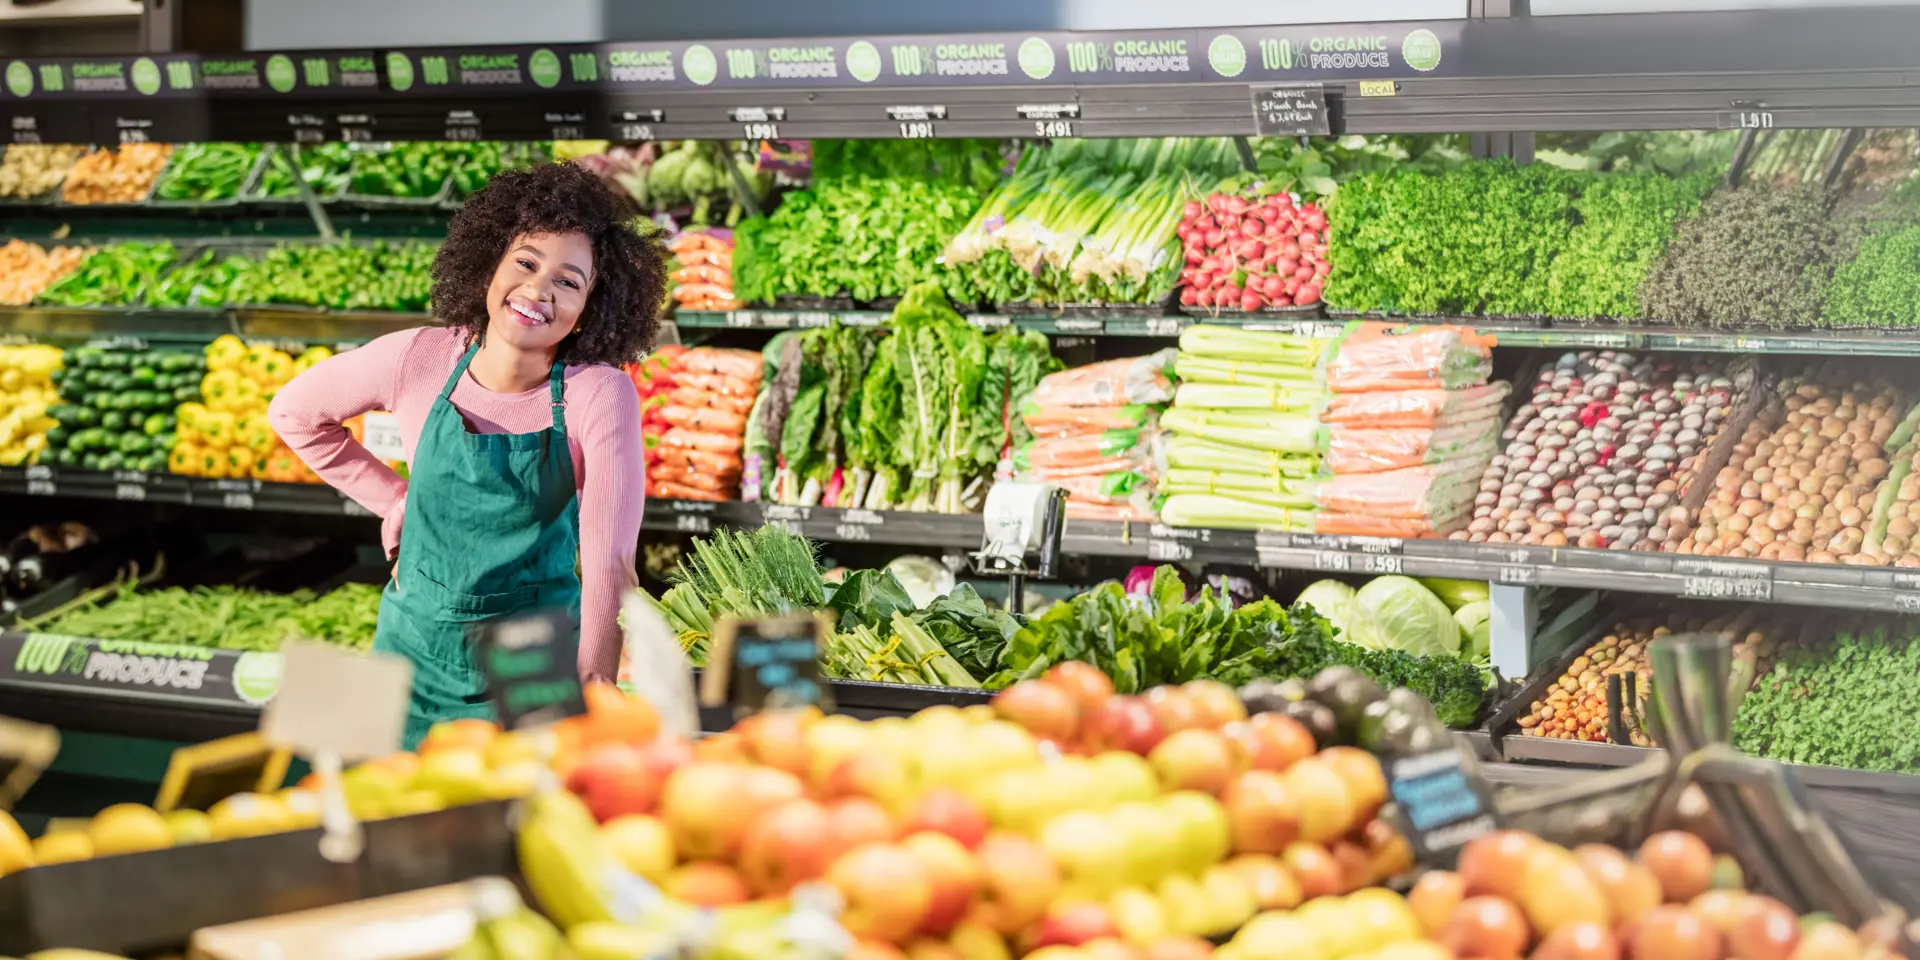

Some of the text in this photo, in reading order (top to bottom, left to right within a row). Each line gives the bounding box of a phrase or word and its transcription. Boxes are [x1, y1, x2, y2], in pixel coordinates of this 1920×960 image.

[769, 47, 835, 62] ORGANIC
[891, 44, 1006, 75] 100% ORGANIC
[1066, 42, 1112, 73] 100%
[1114, 40, 1187, 56] ORGANIC
[1259, 38, 1308, 70] 100%
[1309, 36, 1388, 53] ORGANIC
[1310, 53, 1390, 69] PRODUCE
[769, 62, 838, 78] PRODUCE
[936, 59, 1009, 75] PRODUCE
[1115, 55, 1190, 73] PRODUCE
[1362, 86, 1394, 96] LOCAL
[84, 651, 209, 690] PRODUCE
